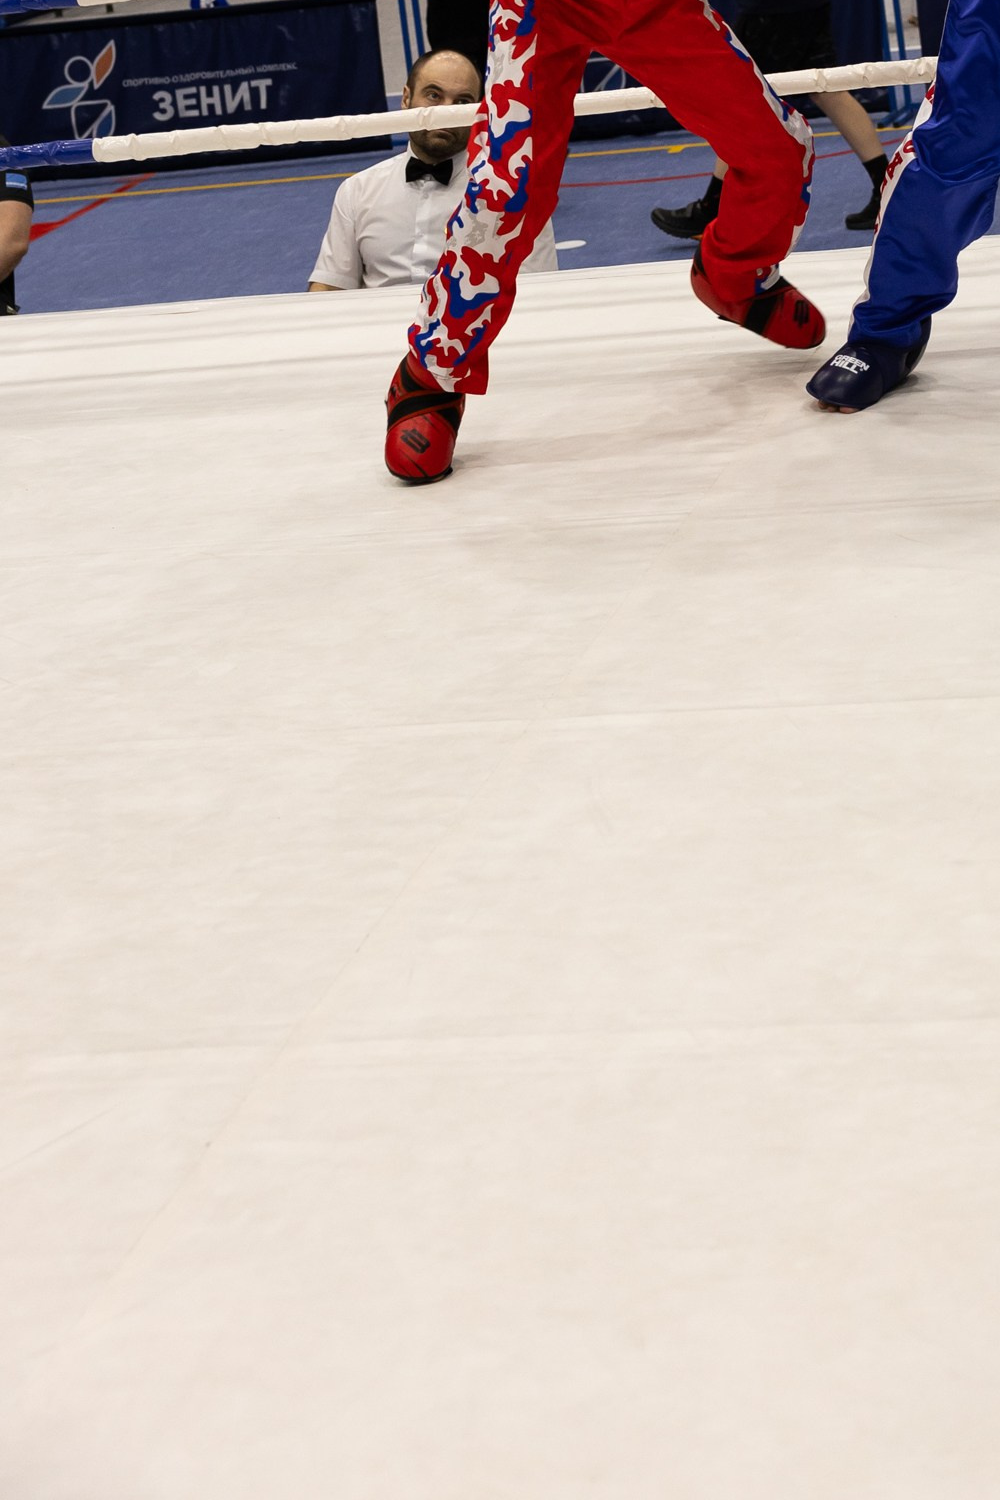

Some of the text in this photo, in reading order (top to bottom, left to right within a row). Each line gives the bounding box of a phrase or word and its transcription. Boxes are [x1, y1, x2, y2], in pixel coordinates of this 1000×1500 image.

[256, 62, 299, 74] КОМПЛЕКС
[151, 78, 273, 122] ЗЕНИТ
[830, 359, 858, 374] HILL
[834, 355, 870, 371] GREEN
